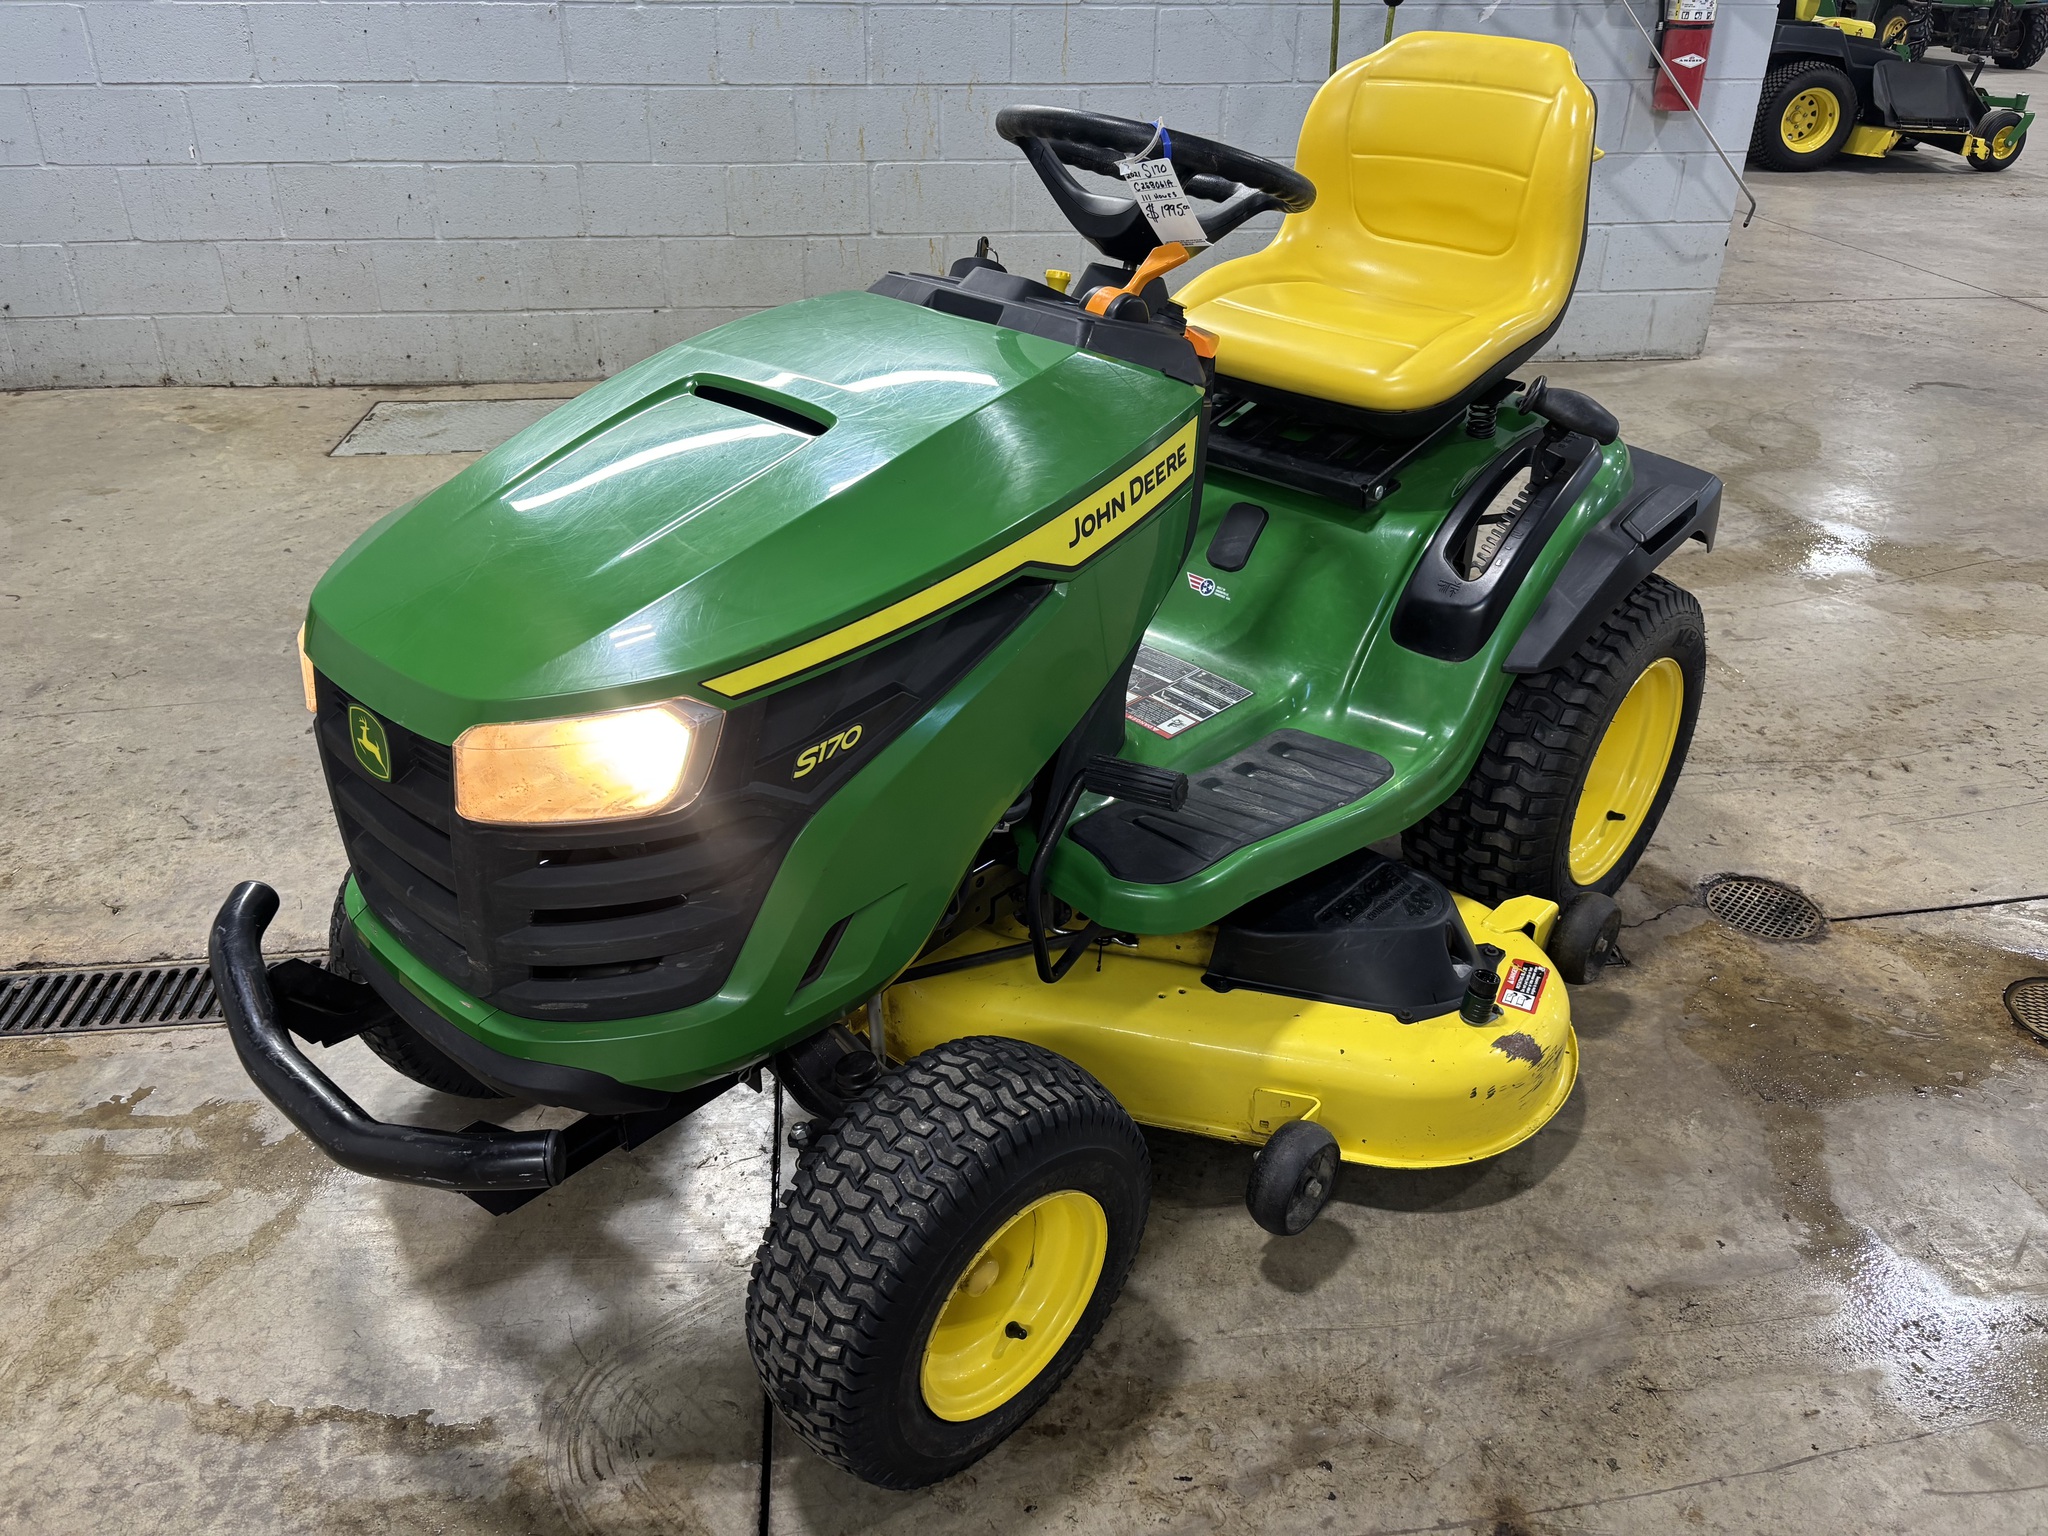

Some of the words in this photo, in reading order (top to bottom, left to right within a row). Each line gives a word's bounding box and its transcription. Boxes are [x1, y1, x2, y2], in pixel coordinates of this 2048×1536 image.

[1126, 172, 1142, 180] 2021
[1141, 163, 1167, 178] S170
[1068, 490, 1126, 549] JOHN
[1129, 442, 1188, 506] DEERE
[1127, 714, 1154, 729] DANGER
[793, 724, 863, 779] S170
